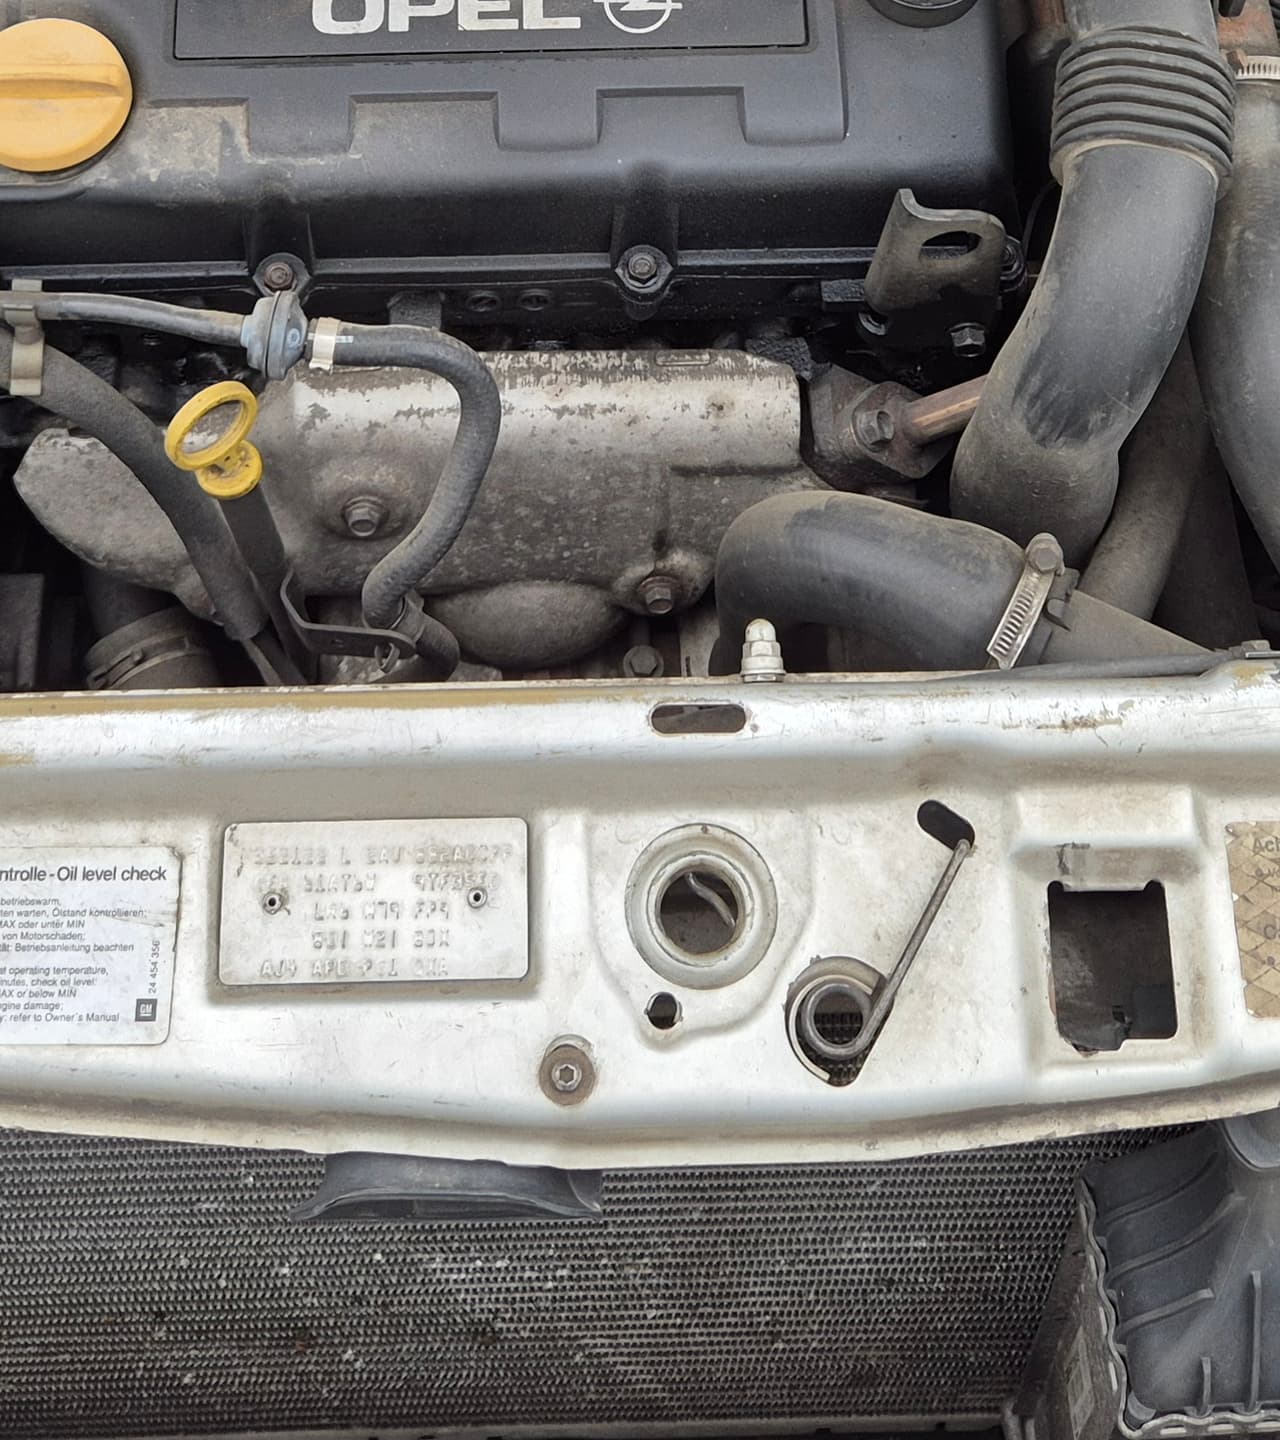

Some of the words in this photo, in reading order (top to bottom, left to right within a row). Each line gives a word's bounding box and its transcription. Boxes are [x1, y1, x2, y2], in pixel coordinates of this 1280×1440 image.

[56, 866, 77, 881] Oil
[82, 866, 116, 881] level
[121, 865, 167, 881] check
[52, 908, 86, 917] Ölstand
[18, 920, 38, 928] oder
[41, 920, 63, 928] unter
[66, 920, 85, 928] MIN
[15, 943, 91, 953] Betriebsanleitung
[94, 943, 134, 952] beachten
[151, 940, 160, 958] 356
[9, 967, 50, 977] operating
[149, 961, 158, 978] 454
[31, 978, 57, 986] check
[60, 978, 70, 986] oil
[148, 982, 156, 994] 24
[17, 990, 27, 998] or
[28, 990, 55, 998] below
[58, 990, 77, 998] MIN
[9, 1013, 31, 1022] refer
[34, 1013, 42, 1022] to
[86, 1013, 120, 1022] Manual
